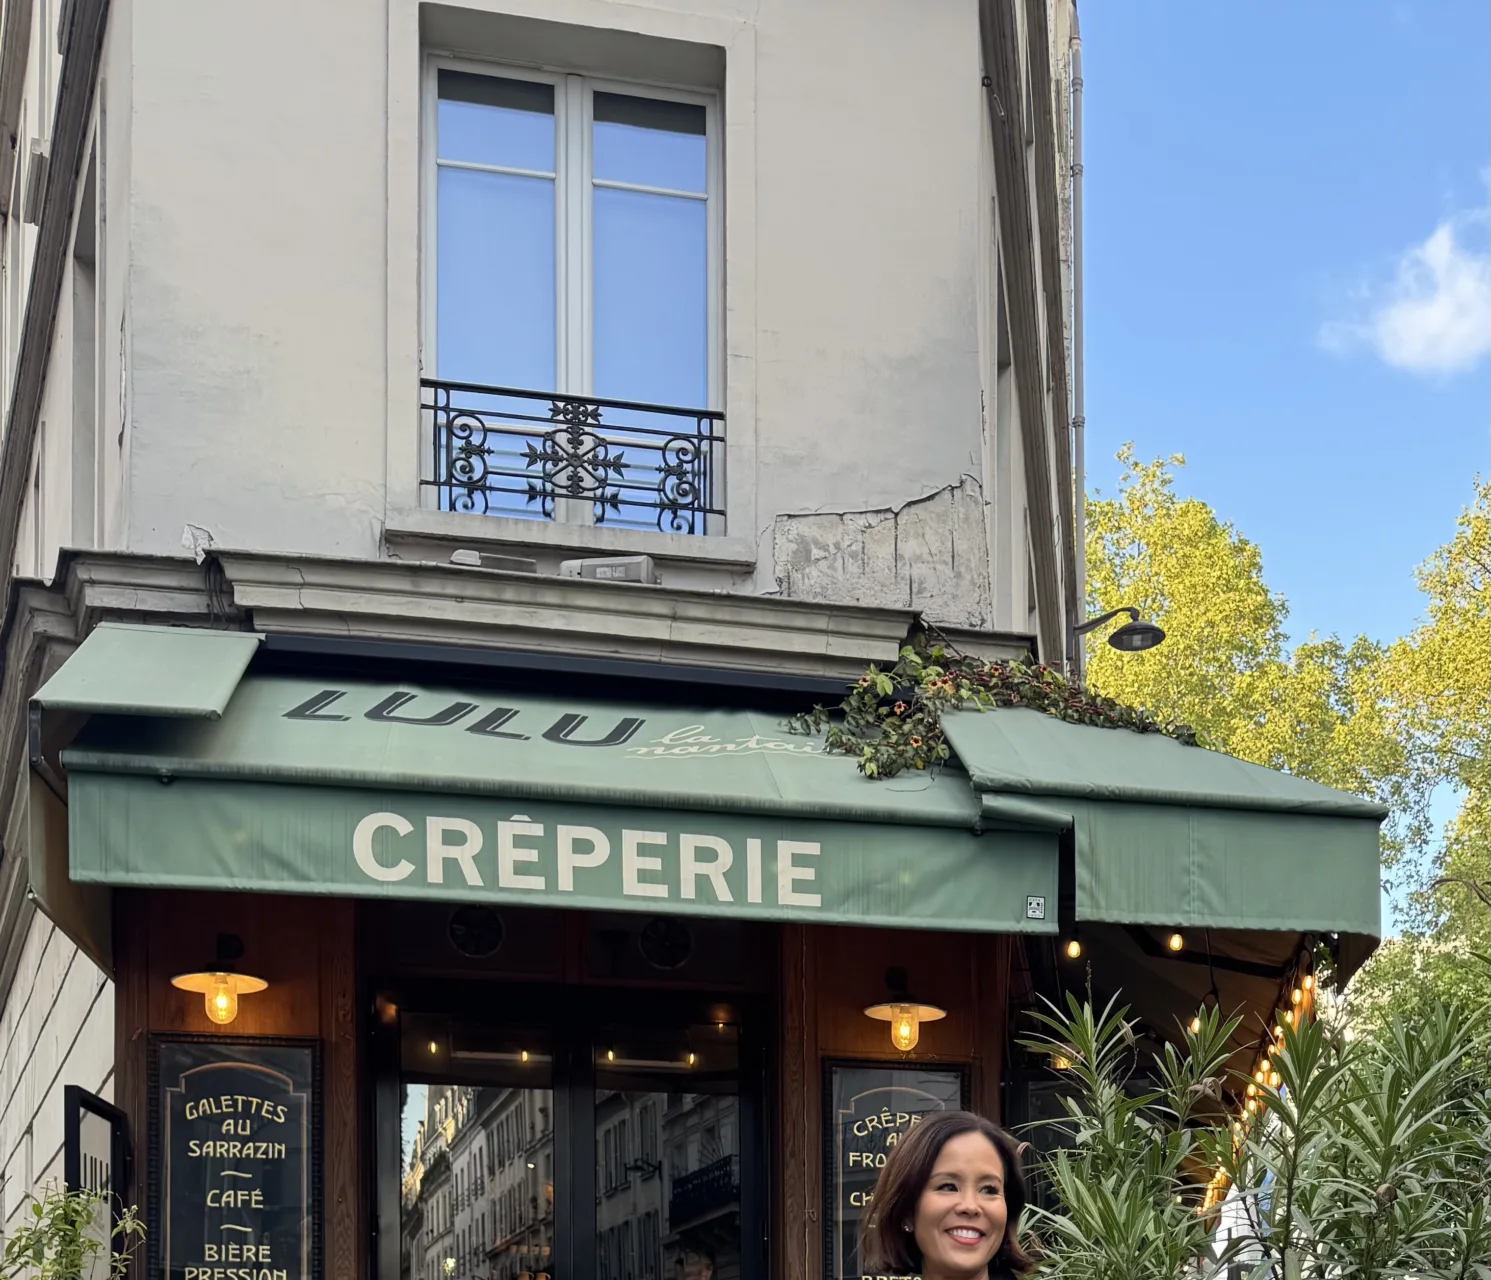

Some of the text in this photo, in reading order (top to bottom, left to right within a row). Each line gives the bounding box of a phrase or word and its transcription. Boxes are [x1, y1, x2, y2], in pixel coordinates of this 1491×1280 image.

[281, 689, 646, 747] LULU
[626, 735, 847, 755] nantai
[649, 724, 721, 745] la
[352, 811, 822, 907] CRÊPERIE
[185, 1095, 288, 1123] GALETTES
[221, 1119, 250, 1135] AU
[853, 1106, 922, 1136] CRÊPE
[187, 1140, 286, 1159] SARRAZIN
[886, 1132, 902, 1147] A
[849, 1152, 887, 1168] FRO
[206, 1188, 264, 1209] CAFÉ
[850, 1192, 875, 1207] CH
[204, 1241, 272, 1262] BIÈRE
